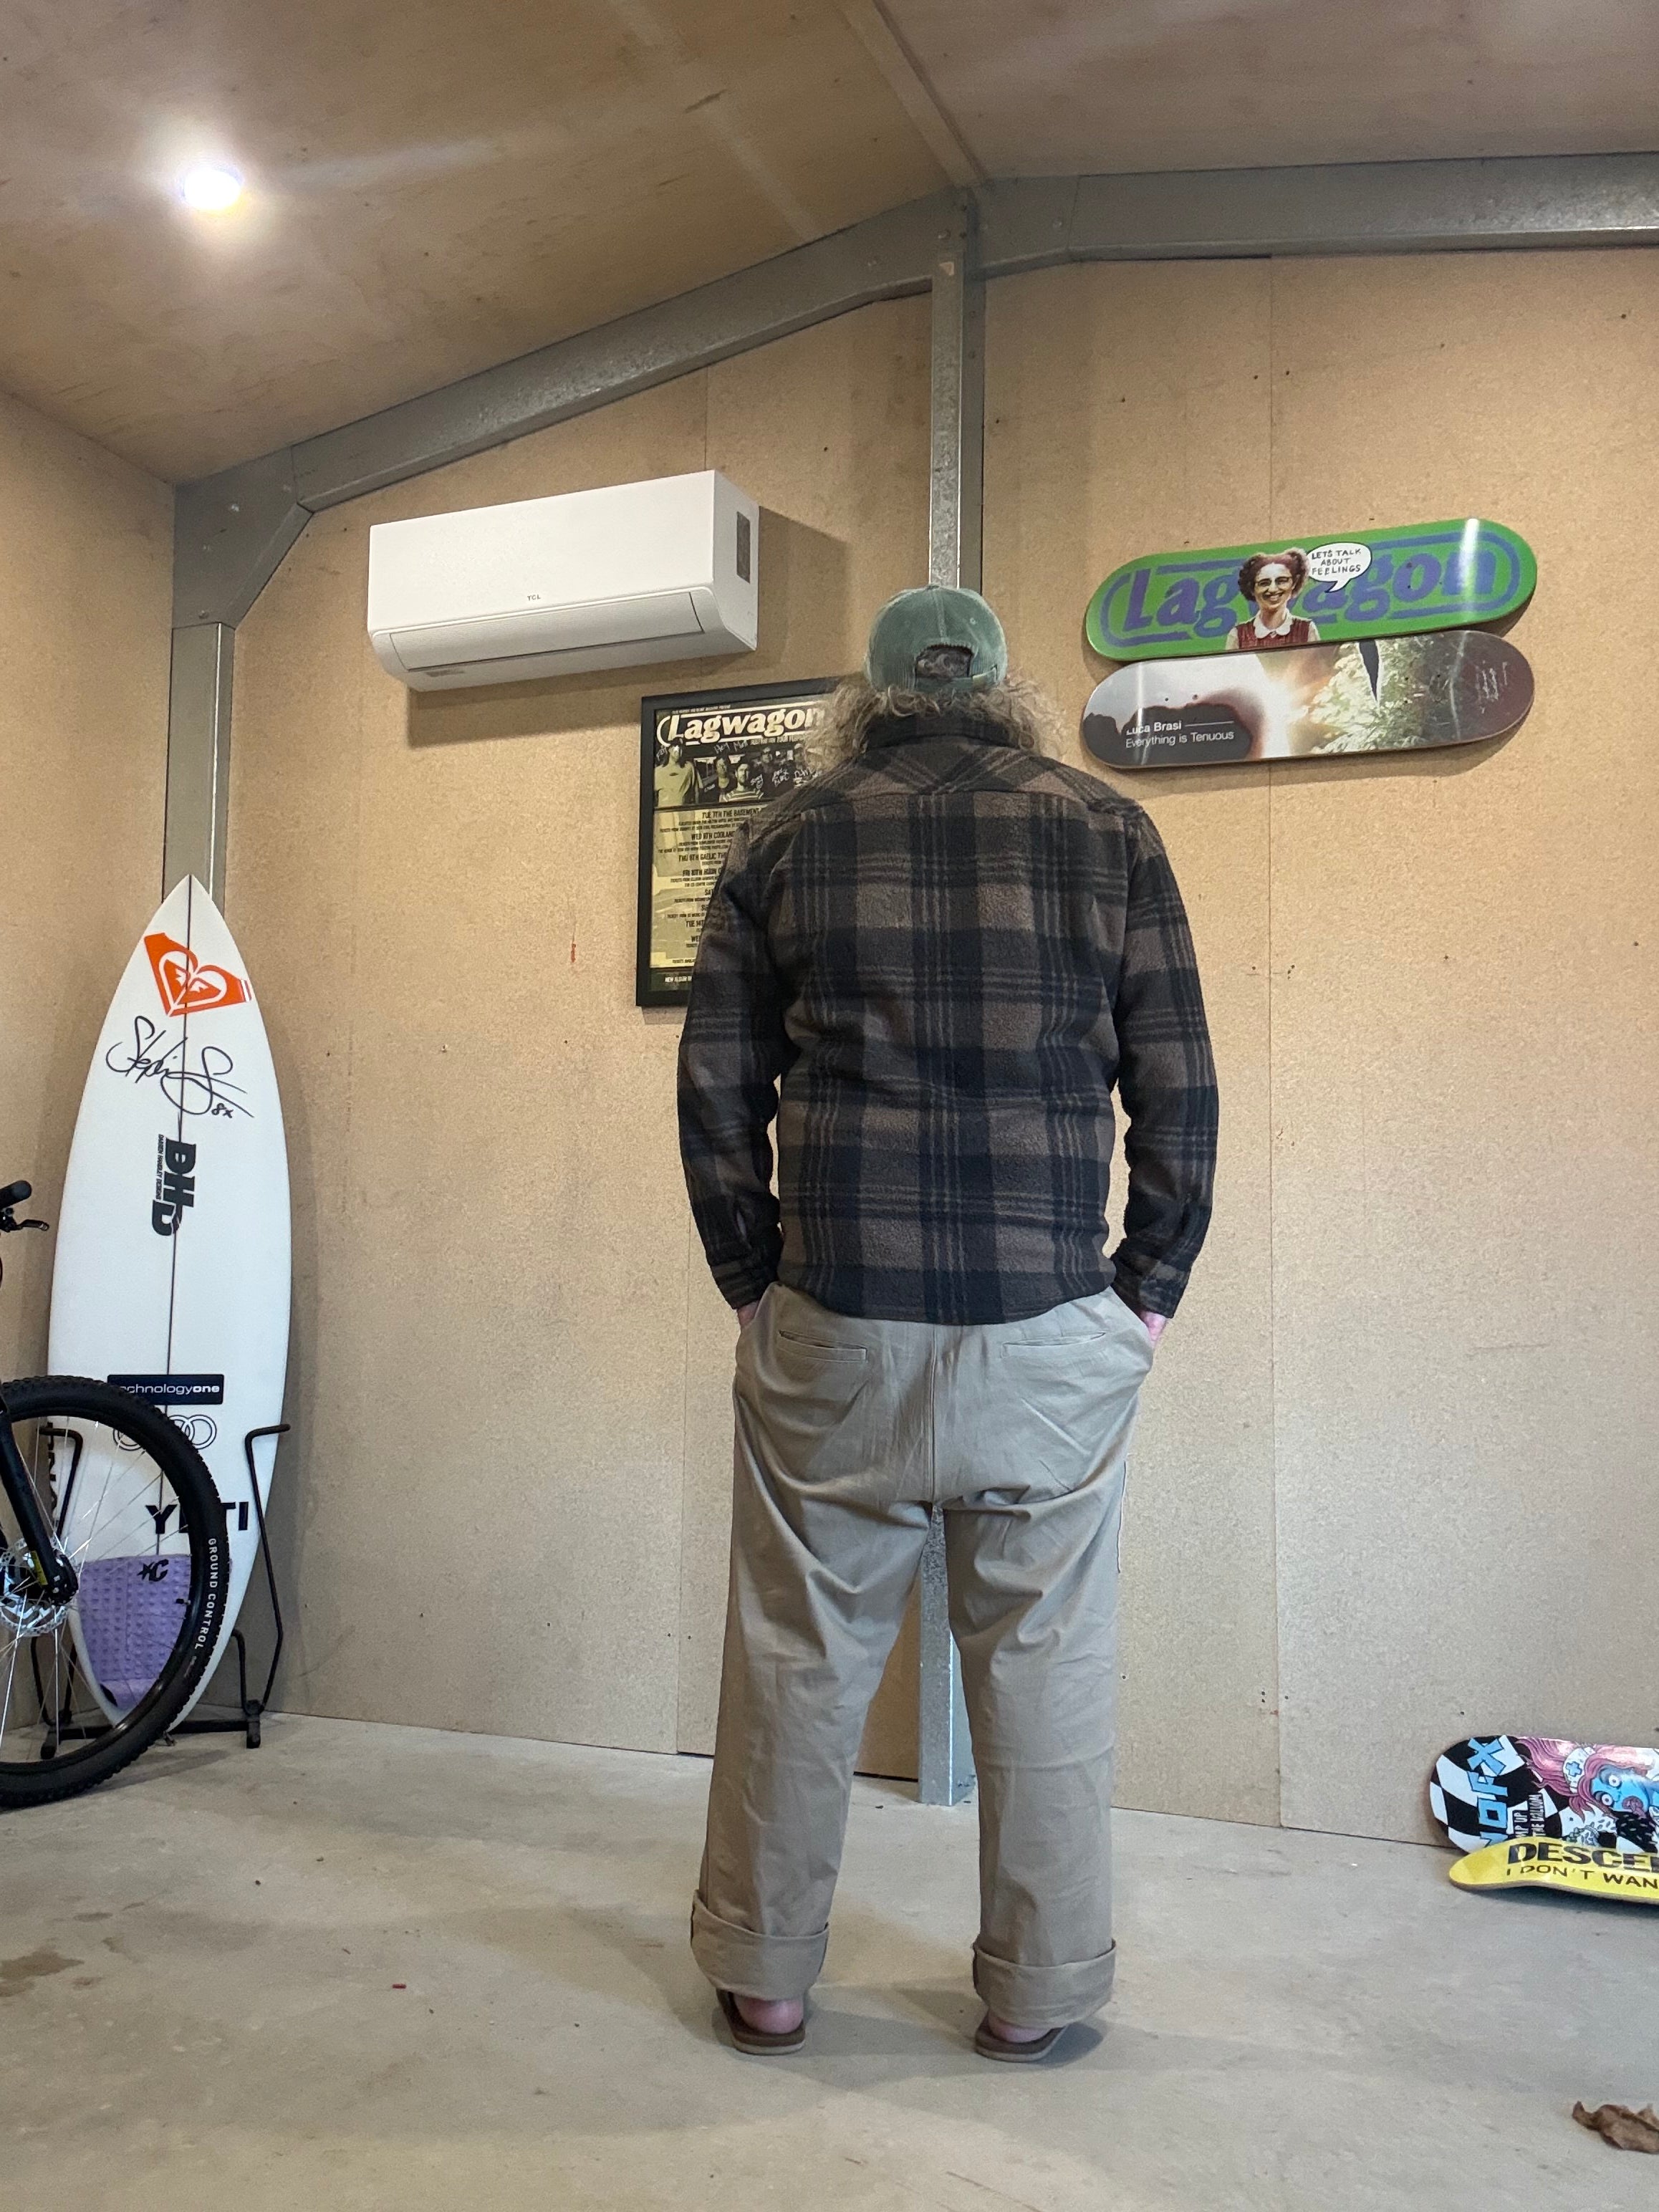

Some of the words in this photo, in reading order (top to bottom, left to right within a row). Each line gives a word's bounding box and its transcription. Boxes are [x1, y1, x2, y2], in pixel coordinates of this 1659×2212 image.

[1335, 548, 1362, 557] TALK
[1312, 564, 1362, 576] FEELINGS
[1320, 557, 1352, 567] ABOUT
[1123, 549, 1495, 637] Lagagon
[1125, 723, 1151, 736] Luca
[1153, 720, 1182, 732] Brasi
[1125, 734, 1176, 749] Everything
[1178, 733, 1188, 744] is
[1190, 731, 1235, 743] Tenuous
[151, 1137, 197, 1236] DHD
[120, 1383, 220, 1395] chnologyone
[208, 1537, 218, 1589] GROUND
[194, 1592, 216, 1650] CONTROL
[1513, 1812, 1529, 1823] UP
[1530, 1823, 1546, 1837] THE
[1519, 1865, 1595, 1880] DON'T
[1602, 1872, 1659, 1890] WAN
